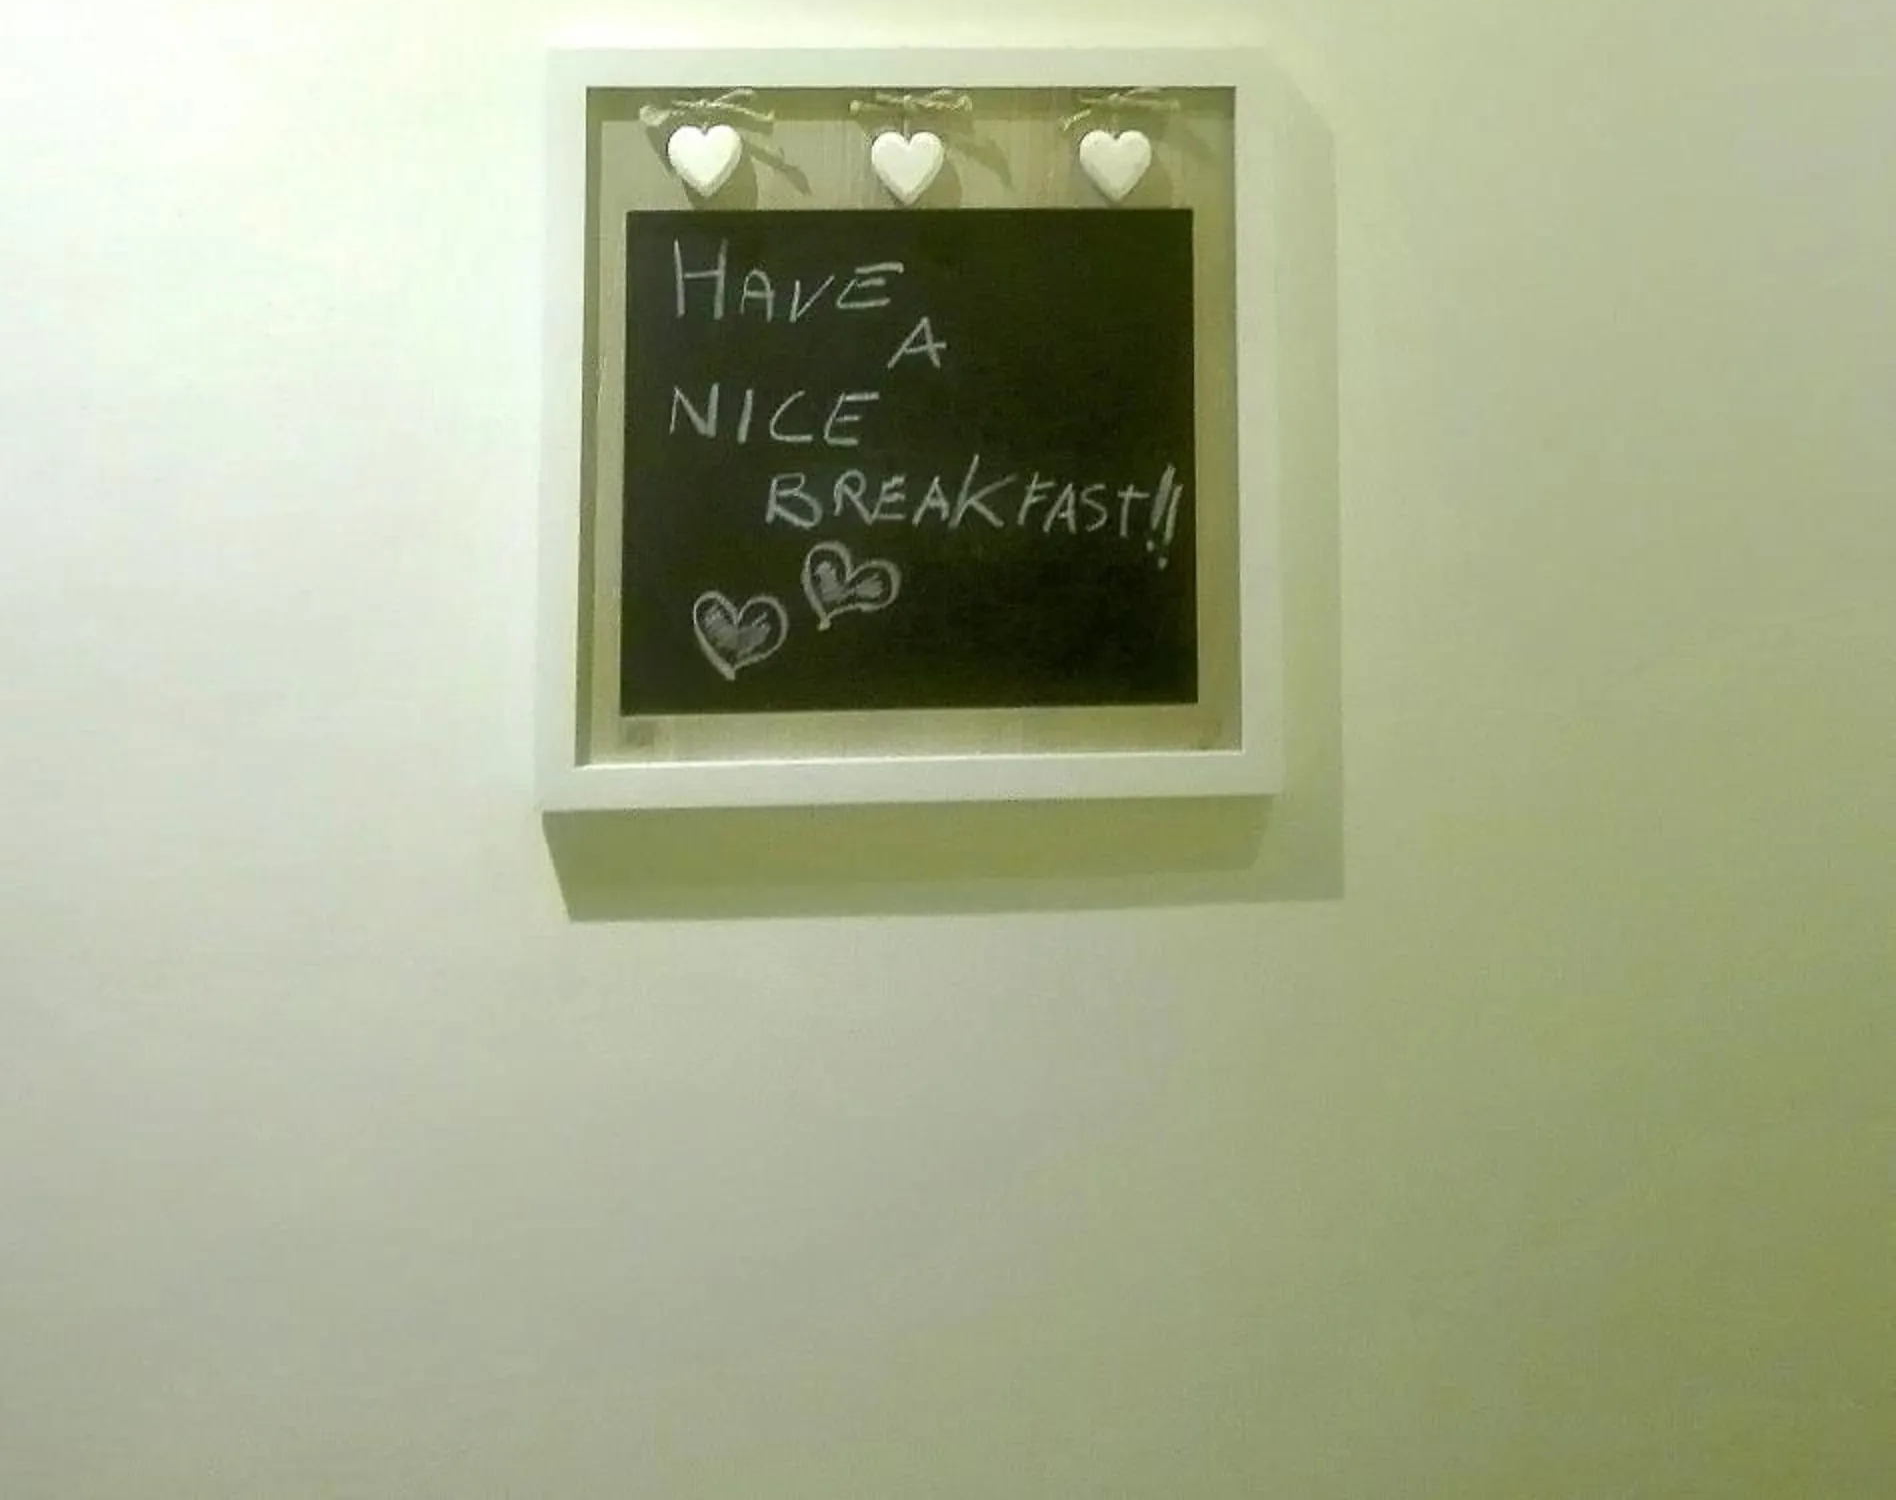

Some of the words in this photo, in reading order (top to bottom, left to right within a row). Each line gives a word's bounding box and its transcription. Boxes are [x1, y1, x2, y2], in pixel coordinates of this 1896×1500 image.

[674, 239, 904, 322] HAVE
[888, 317, 947, 368] A
[670, 383, 879, 445] NICE
[766, 455, 1184, 570] BREAKFAST!!
